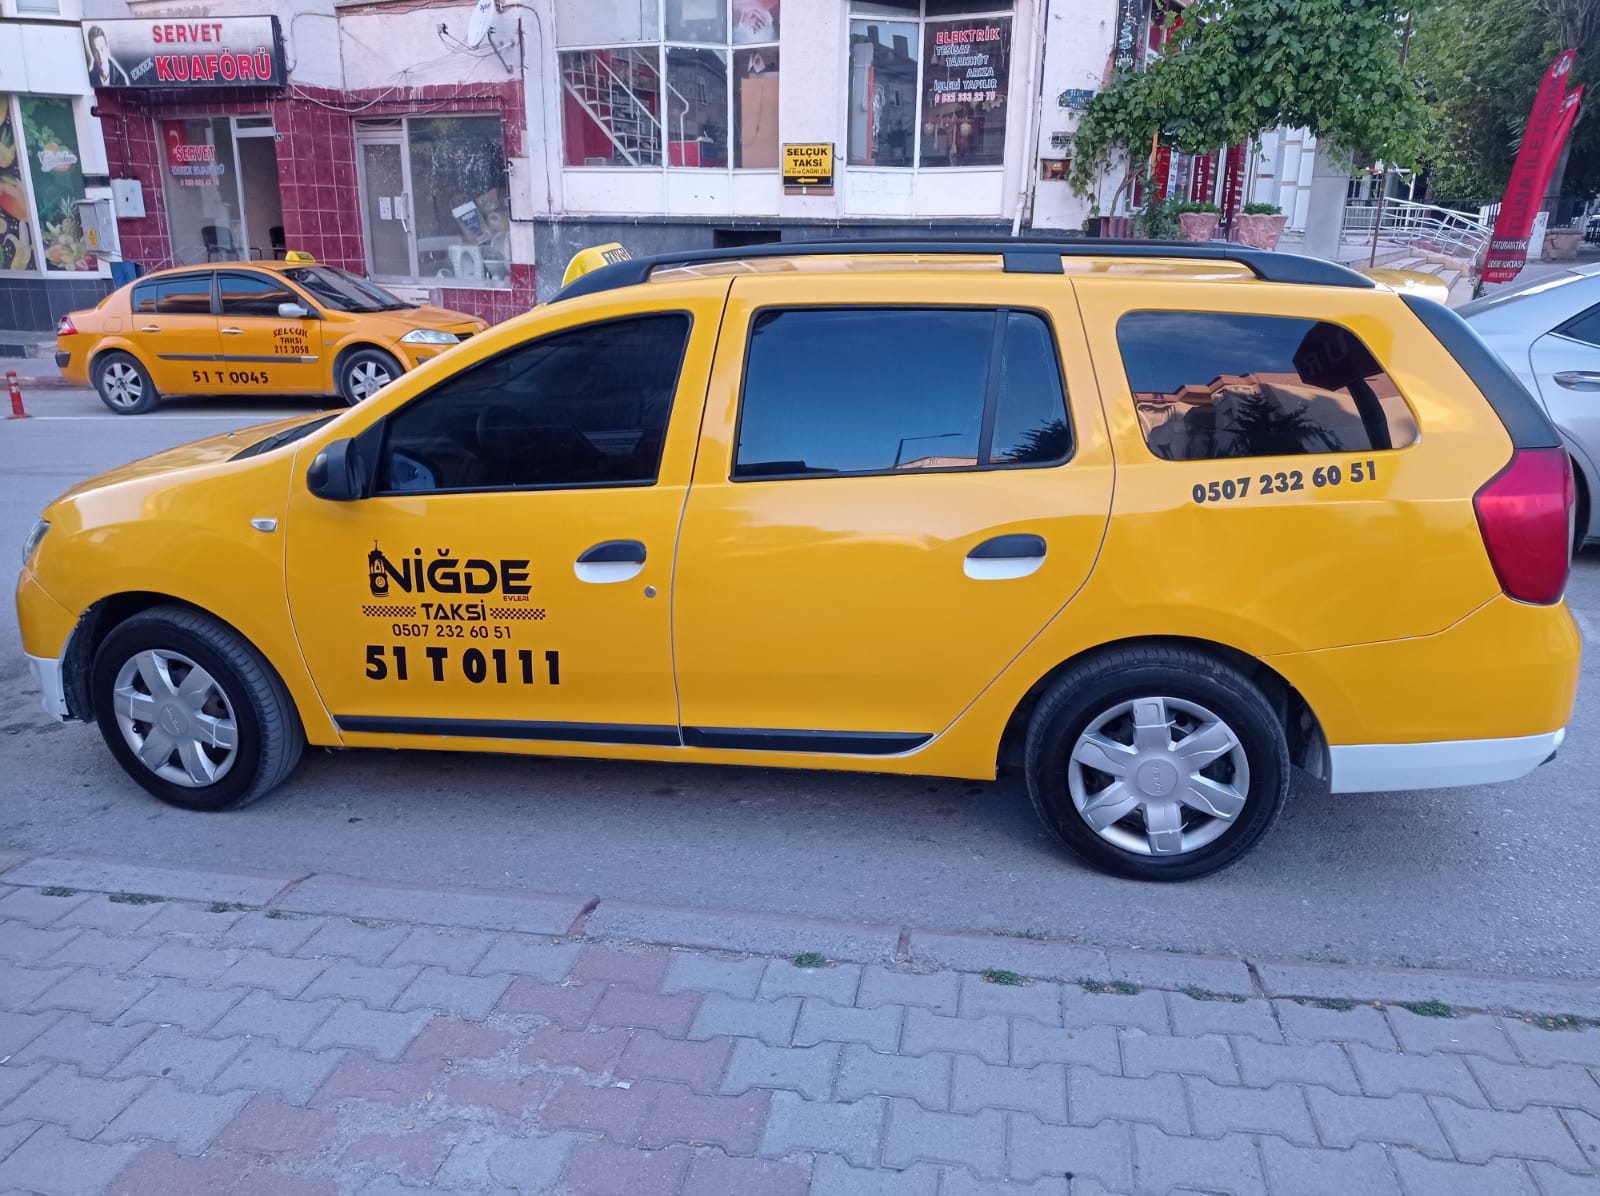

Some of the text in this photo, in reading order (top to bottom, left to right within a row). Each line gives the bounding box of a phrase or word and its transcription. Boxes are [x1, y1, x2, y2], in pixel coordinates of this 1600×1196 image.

[152, 24, 223, 43] SERVET
[936, 25, 1000, 44] ELEKTRİK
[155, 47, 272, 81] KUAFÖRÜ
[175, 145, 215, 161] SERVET
[786, 148, 828, 158] SELÇUK
[793, 158, 822, 167] TAKSİ
[274, 345, 288, 354] 213
[192, 371, 269, 384] 51 T 0045
[1192, 461, 1377, 503] 0507 232 60 51
[369, 547, 533, 596] NİĞDE
[421, 599, 487, 621] TAKSİ
[392, 623, 511, 639] 0507 232 60 51
[365, 645, 560, 685] 51 T 0111
